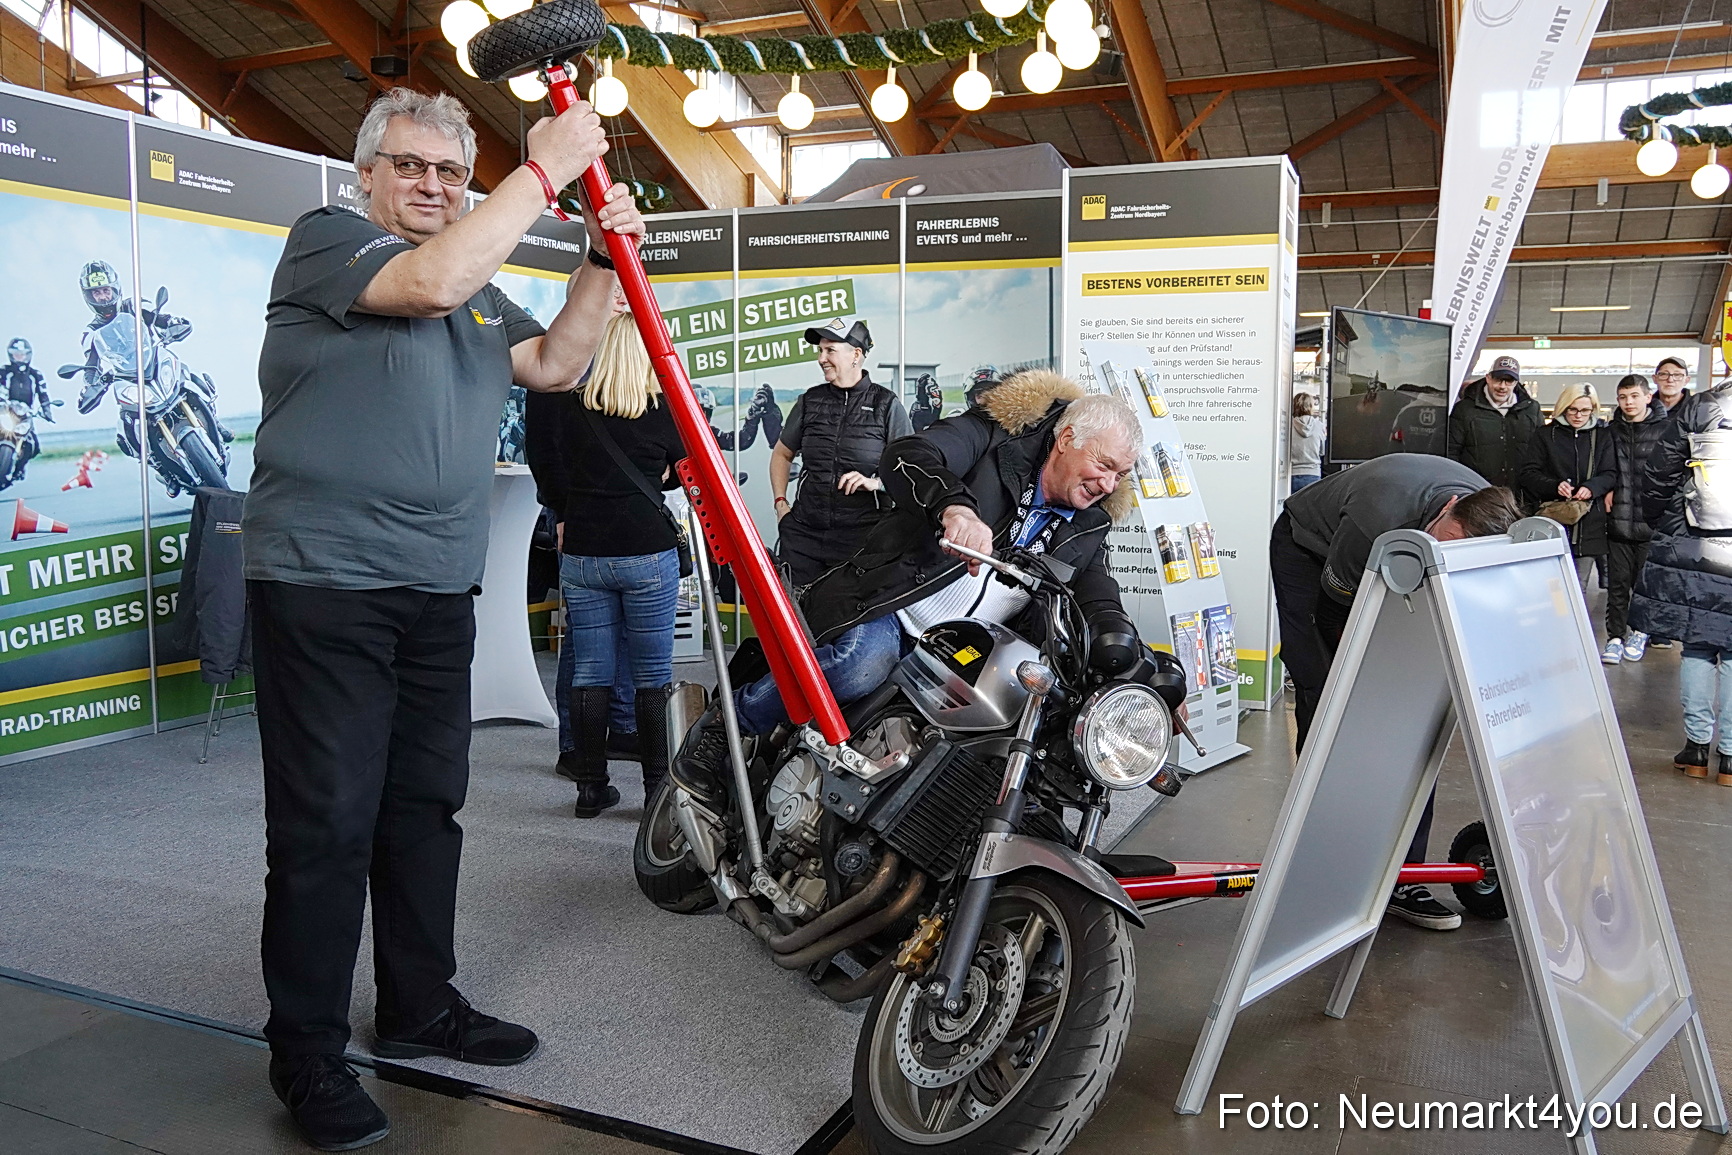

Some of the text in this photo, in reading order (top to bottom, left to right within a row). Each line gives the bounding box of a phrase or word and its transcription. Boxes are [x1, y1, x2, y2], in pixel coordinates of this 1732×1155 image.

[0, 141, 37, 158] mehr
[151, 152, 173, 164] ADAC
[1446, 216, 1491, 324] EBNISWELT
[1545, 5, 1572, 43] MIT
[178, 169, 236, 187] ADAC Fahrsicherheits-
[178, 178, 232, 194] Zentrum Nordbayern
[1083, 196, 1105, 205] ADAC
[1126, 204, 1172, 212] Fahrsicherheits-
[916, 217, 1000, 231] FAHRERLEBNIS
[748, 230, 890, 247] FAHRSICHERHEITSTRAINING
[916, 234, 959, 246] EVENTS
[962, 233, 983, 244] und
[985, 231, 1013, 243] mehr
[1453, 142, 1540, 362] www.erlebniswelt-bayern.de
[1087, 274, 1265, 290] BESTENS VORBEREITET SEIN
[689, 308, 727, 335] EIN
[744, 288, 848, 325] STEIGER
[1080, 315, 1245, 328] Sie glauben, Sie sind bereits ein sicherer
[1080, 329, 1257, 341] Biker? Stellen Sie Ihr Können und Wissen in
[695, 337, 818, 371] BIS ZUM P
[1157, 345, 1171, 353] auf
[1172, 344, 1188, 353] den
[1190, 342, 1233, 352] Prüfstand!
[1184, 358, 1214, 366] werden
[1216, 357, 1230, 366] Sie
[1232, 357, 1263, 366] heraus-
[1162, 372, 1171, 380] in
[1172, 371, 1245, 380] unterschiedlichen
[1163, 385, 1261, 395] anspruchsvolle Fahrma-
[1167, 398, 1253, 408] urch Ihre fahrerische
[1192, 414, 1208, 422] neu
[1210, 412, 1247, 422] erfahren.
[1184, 443, 1207, 451] Hase:
[1196, 453, 1219, 462] Tipps,
[1221, 452, 1235, 460] wie
[1237, 451, 1250, 460] Sie
[28, 543, 136, 591] MEHR
[95, 600, 145, 631] BES
[1, 694, 142, 737] RAD-TRAINING
[1227, 876, 1254, 889] ADAC
